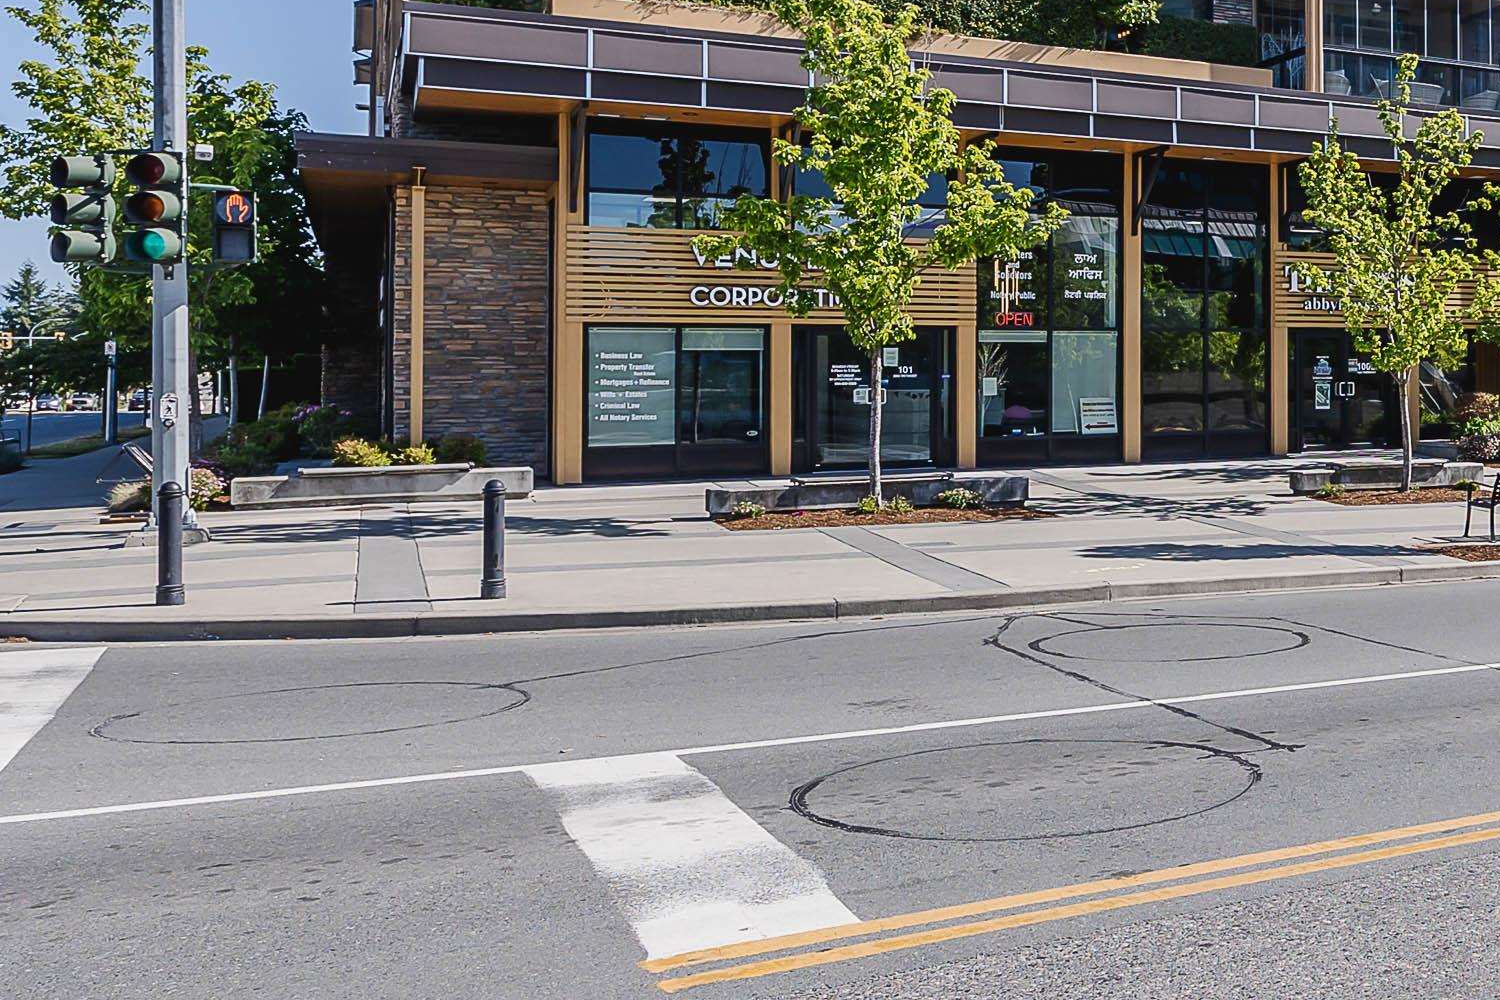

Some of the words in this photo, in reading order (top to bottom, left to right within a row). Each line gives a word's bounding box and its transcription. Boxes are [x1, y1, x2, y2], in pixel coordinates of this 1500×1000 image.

[996, 312, 1032, 326] OPEN
[600, 363, 628, 371] Property
[898, 365, 913, 374] 101
